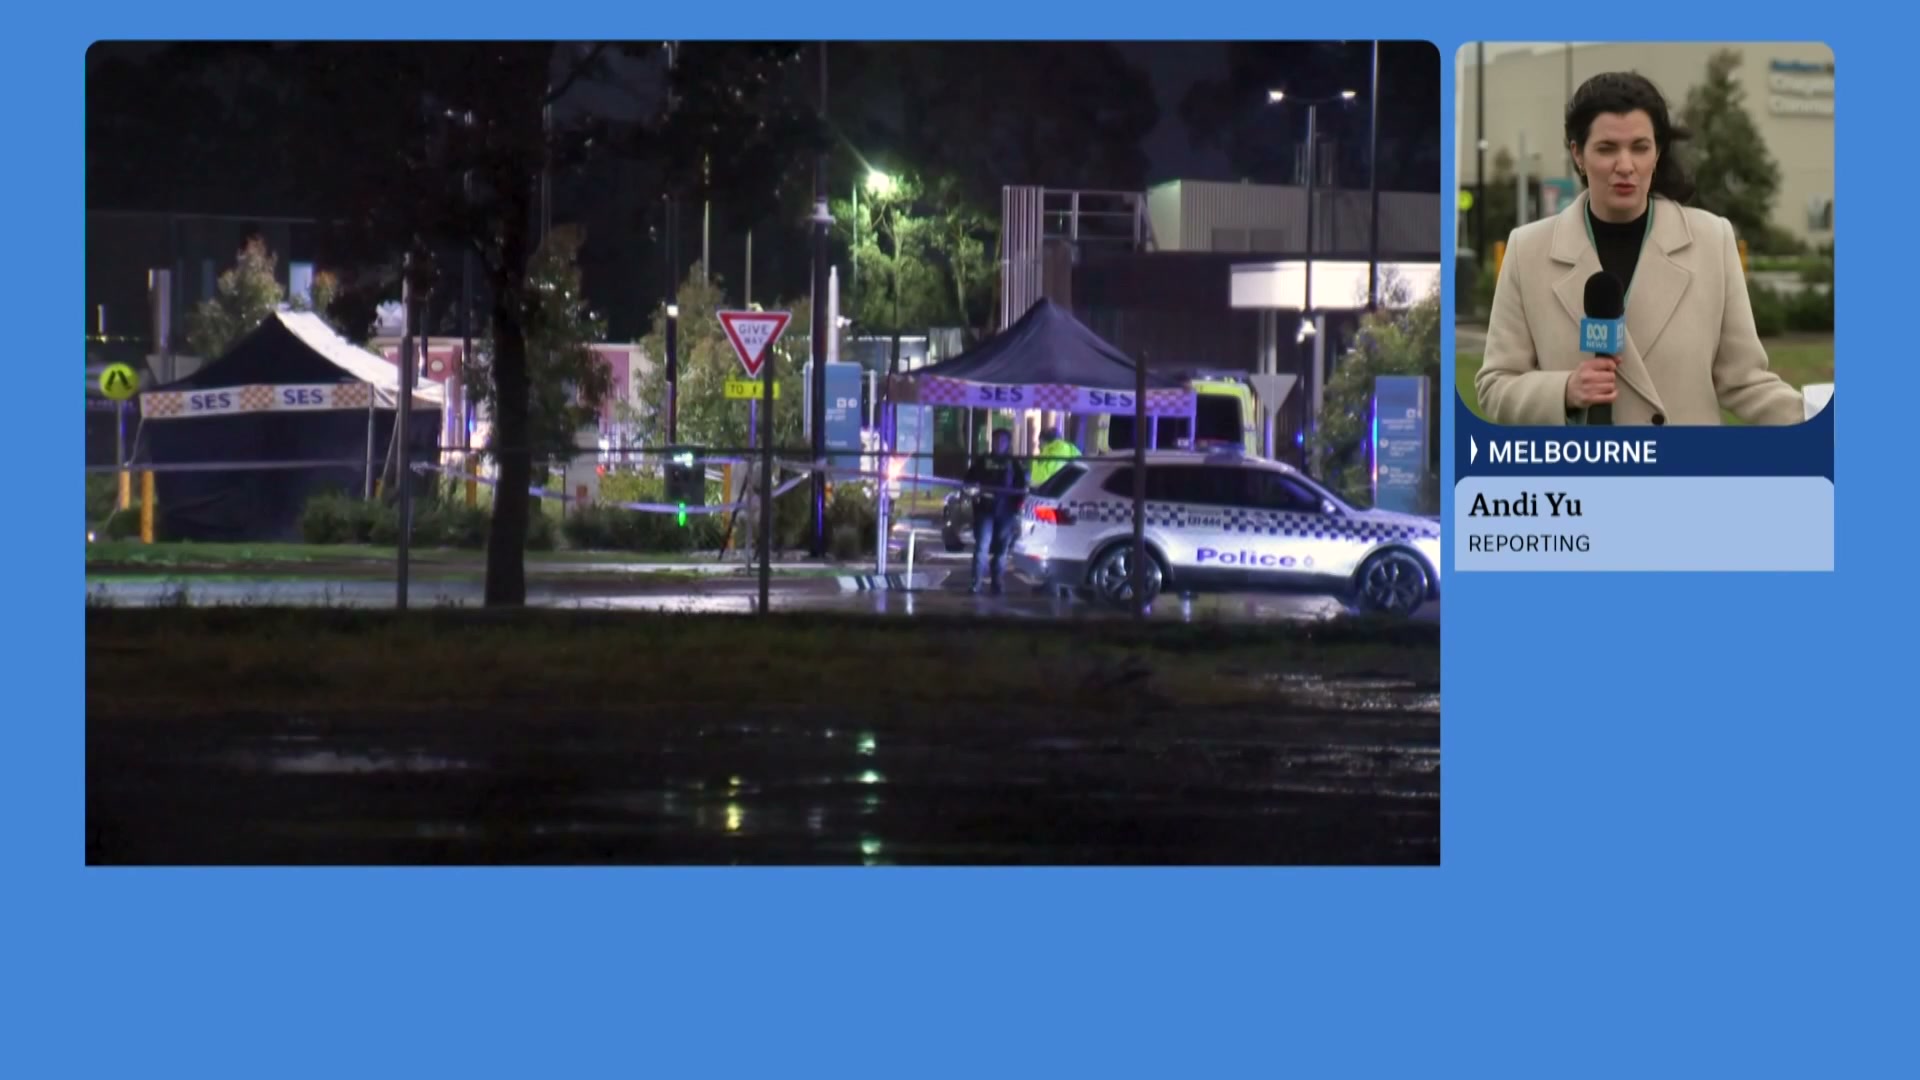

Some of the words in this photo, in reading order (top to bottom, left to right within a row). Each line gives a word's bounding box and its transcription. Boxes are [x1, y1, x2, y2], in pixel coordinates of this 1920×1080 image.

[739, 324, 769, 335] GIVE
[1586, 340, 1608, 349] NEWS
[191, 392, 231, 410] SES
[283, 388, 323, 405] SES
[979, 385, 1023, 402] SES
[1089, 390, 1133, 407] SES
[1196, 548, 1297, 568] Police
